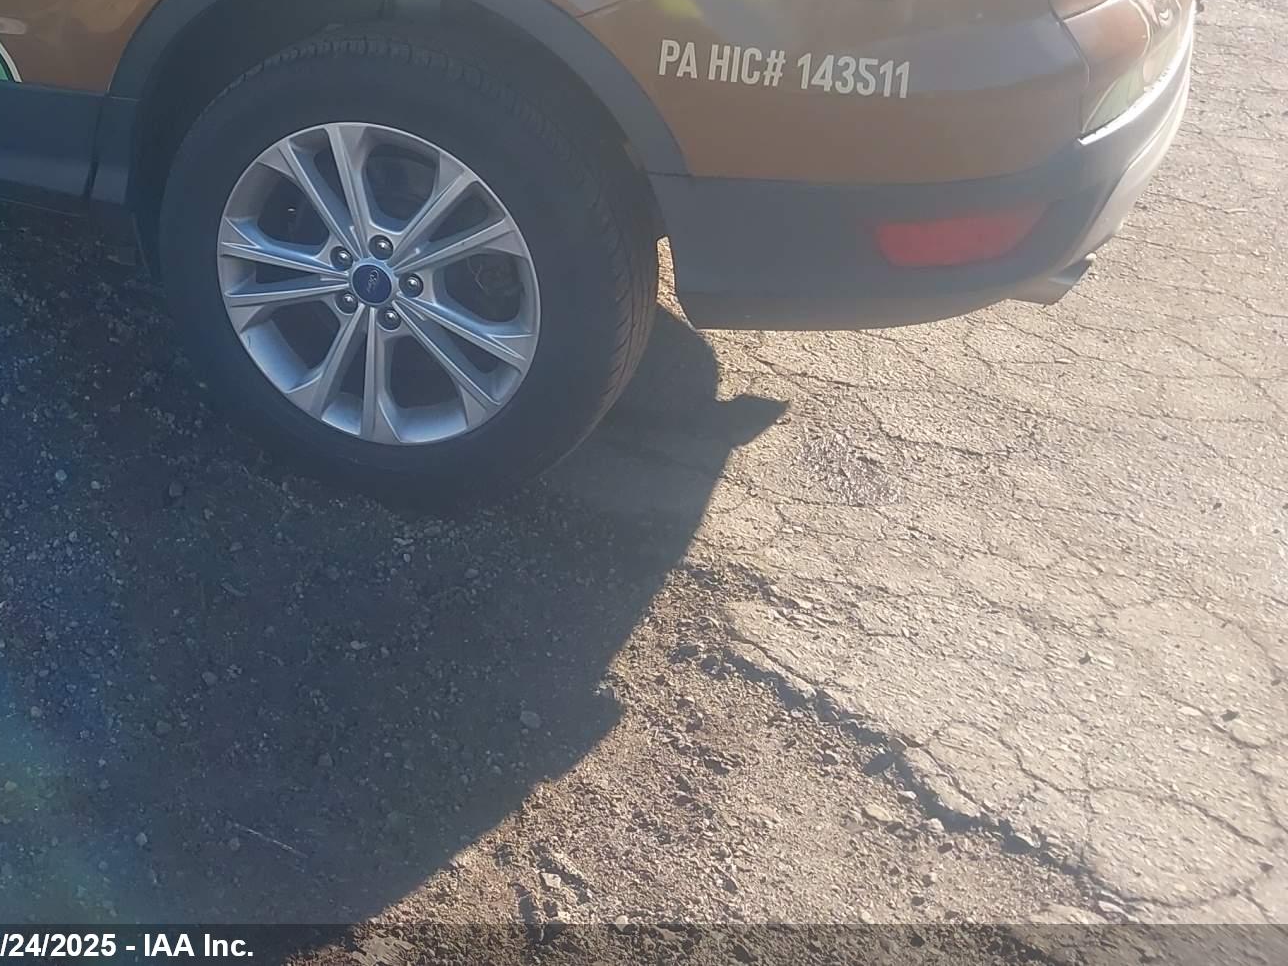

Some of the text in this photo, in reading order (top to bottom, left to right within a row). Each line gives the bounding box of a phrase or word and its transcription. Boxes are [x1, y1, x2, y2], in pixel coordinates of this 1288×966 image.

[658, 39, 911, 98] PA HIC# 143511
